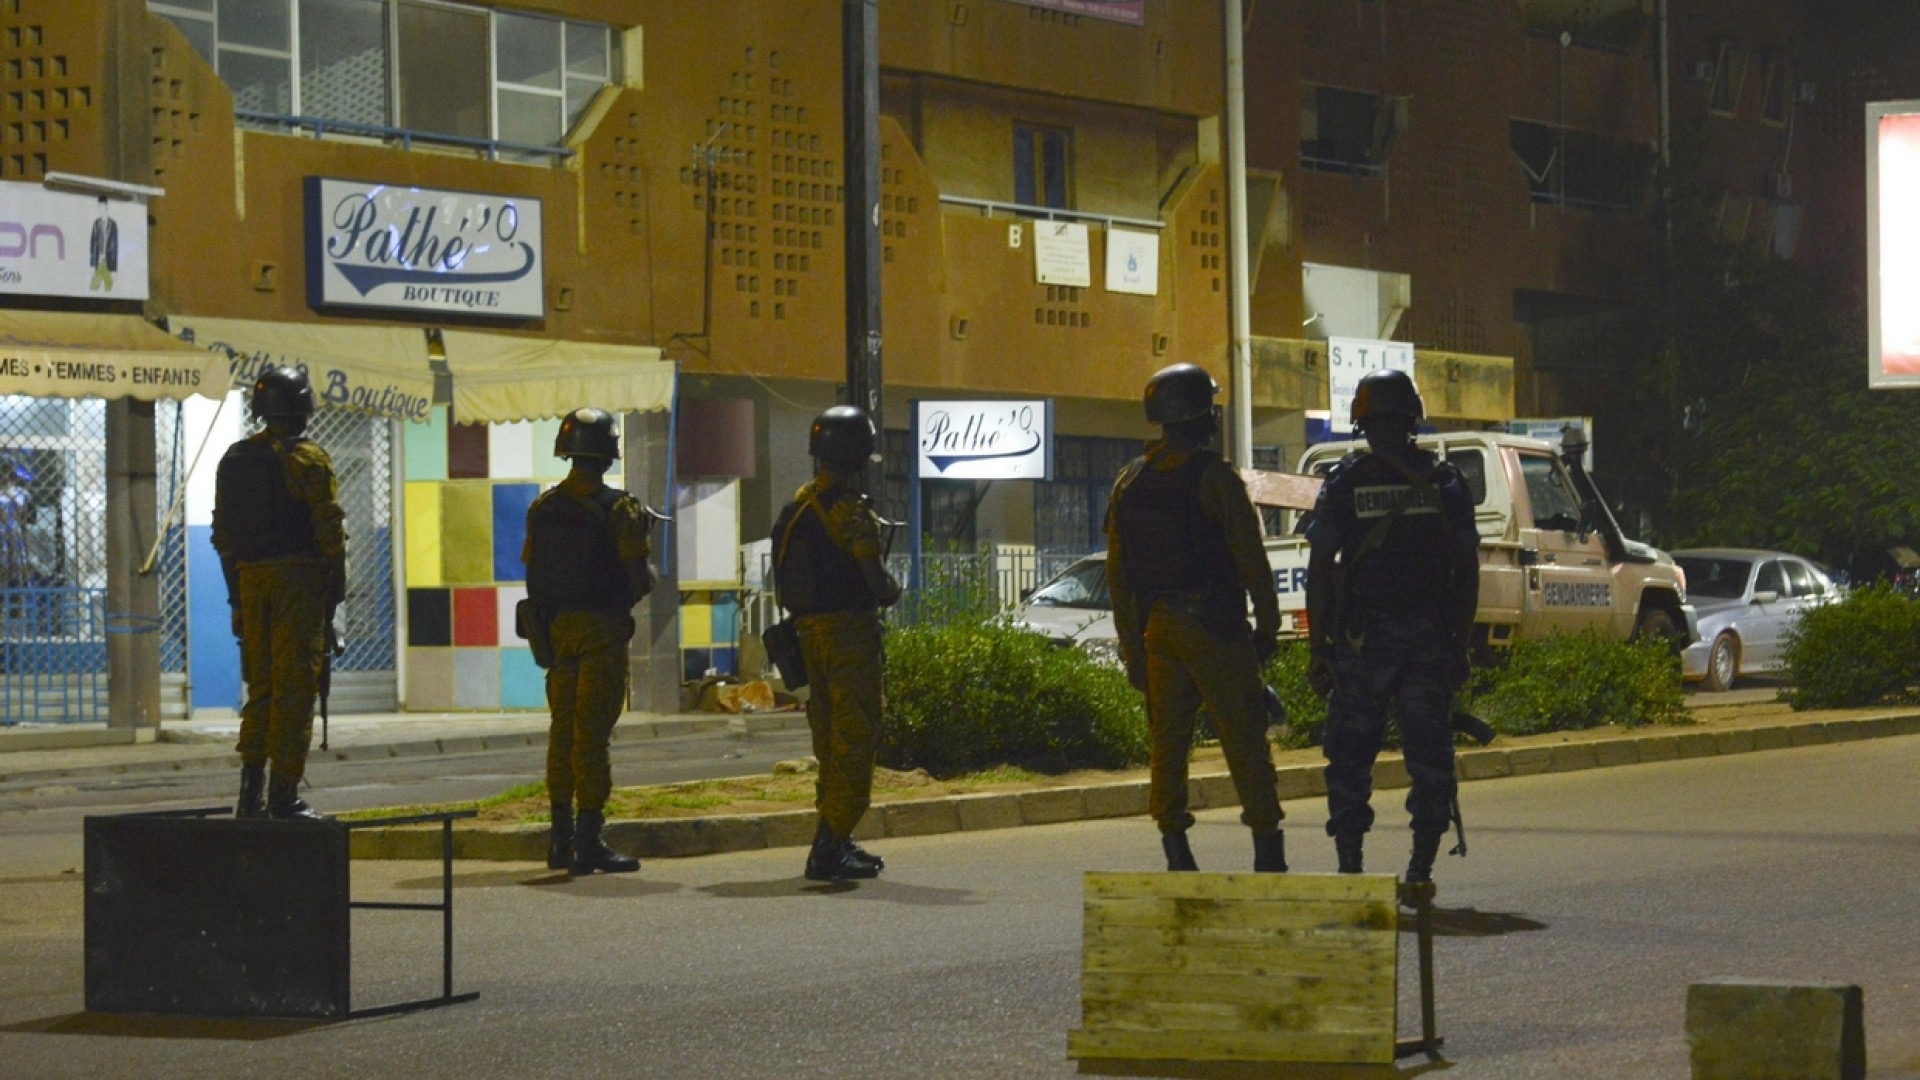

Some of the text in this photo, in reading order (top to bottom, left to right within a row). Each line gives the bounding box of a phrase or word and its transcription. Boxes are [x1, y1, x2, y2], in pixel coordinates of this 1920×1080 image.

[1008, 224, 1022, 248] B
[403, 285, 500, 308] BOUTIQUE
[133, 367, 201, 386] ENFANTS
[321, 369, 428, 420] Boutique
